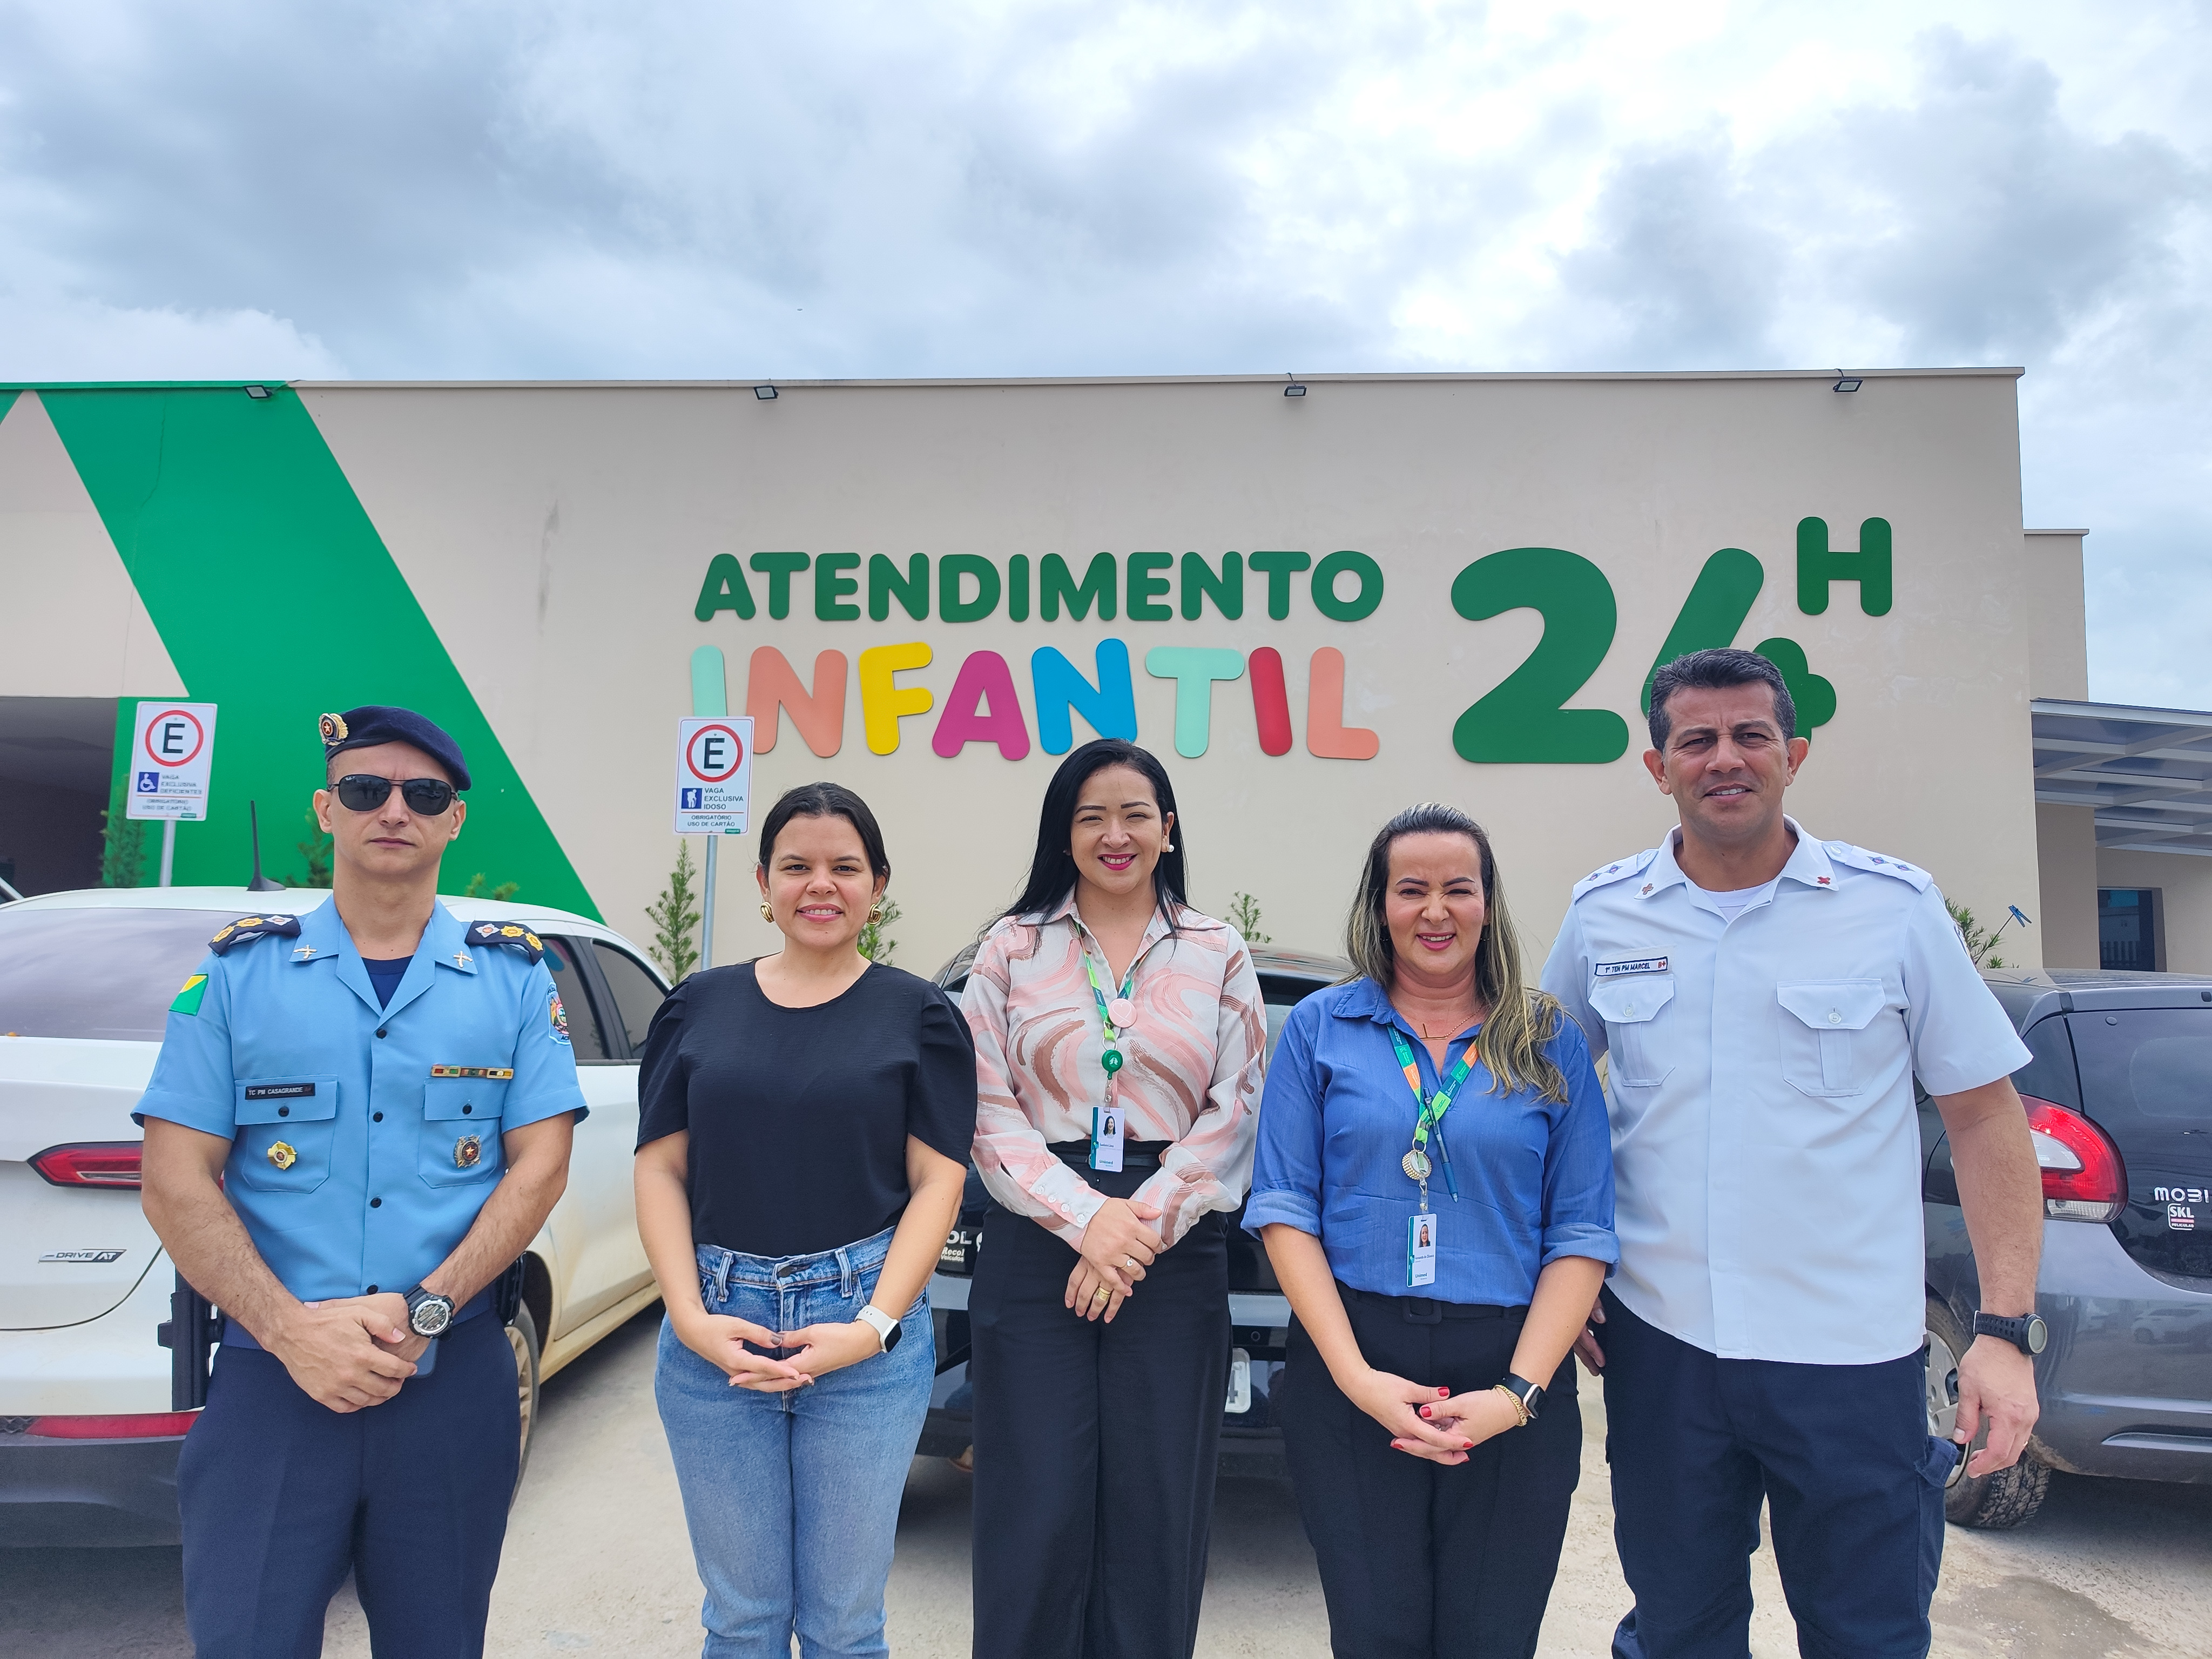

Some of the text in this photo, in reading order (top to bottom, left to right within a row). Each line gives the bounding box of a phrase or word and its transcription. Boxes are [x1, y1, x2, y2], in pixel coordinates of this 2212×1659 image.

[694, 551, 1384, 623] ATENDIMENTO
[691, 638, 1380, 761] INFANTIL
[163, 723, 185, 754] E
[704, 737, 725, 769] E
[1630, 962, 1650, 970] MARCEL
[267, 1087, 304, 1095] CASAGRANDE
[2169, 1206, 2195, 1218] SKL
[946, 1230, 972, 1245] OL
[97, 1252, 117, 1260] AT
[941, 1246, 965, 1256] Recol
